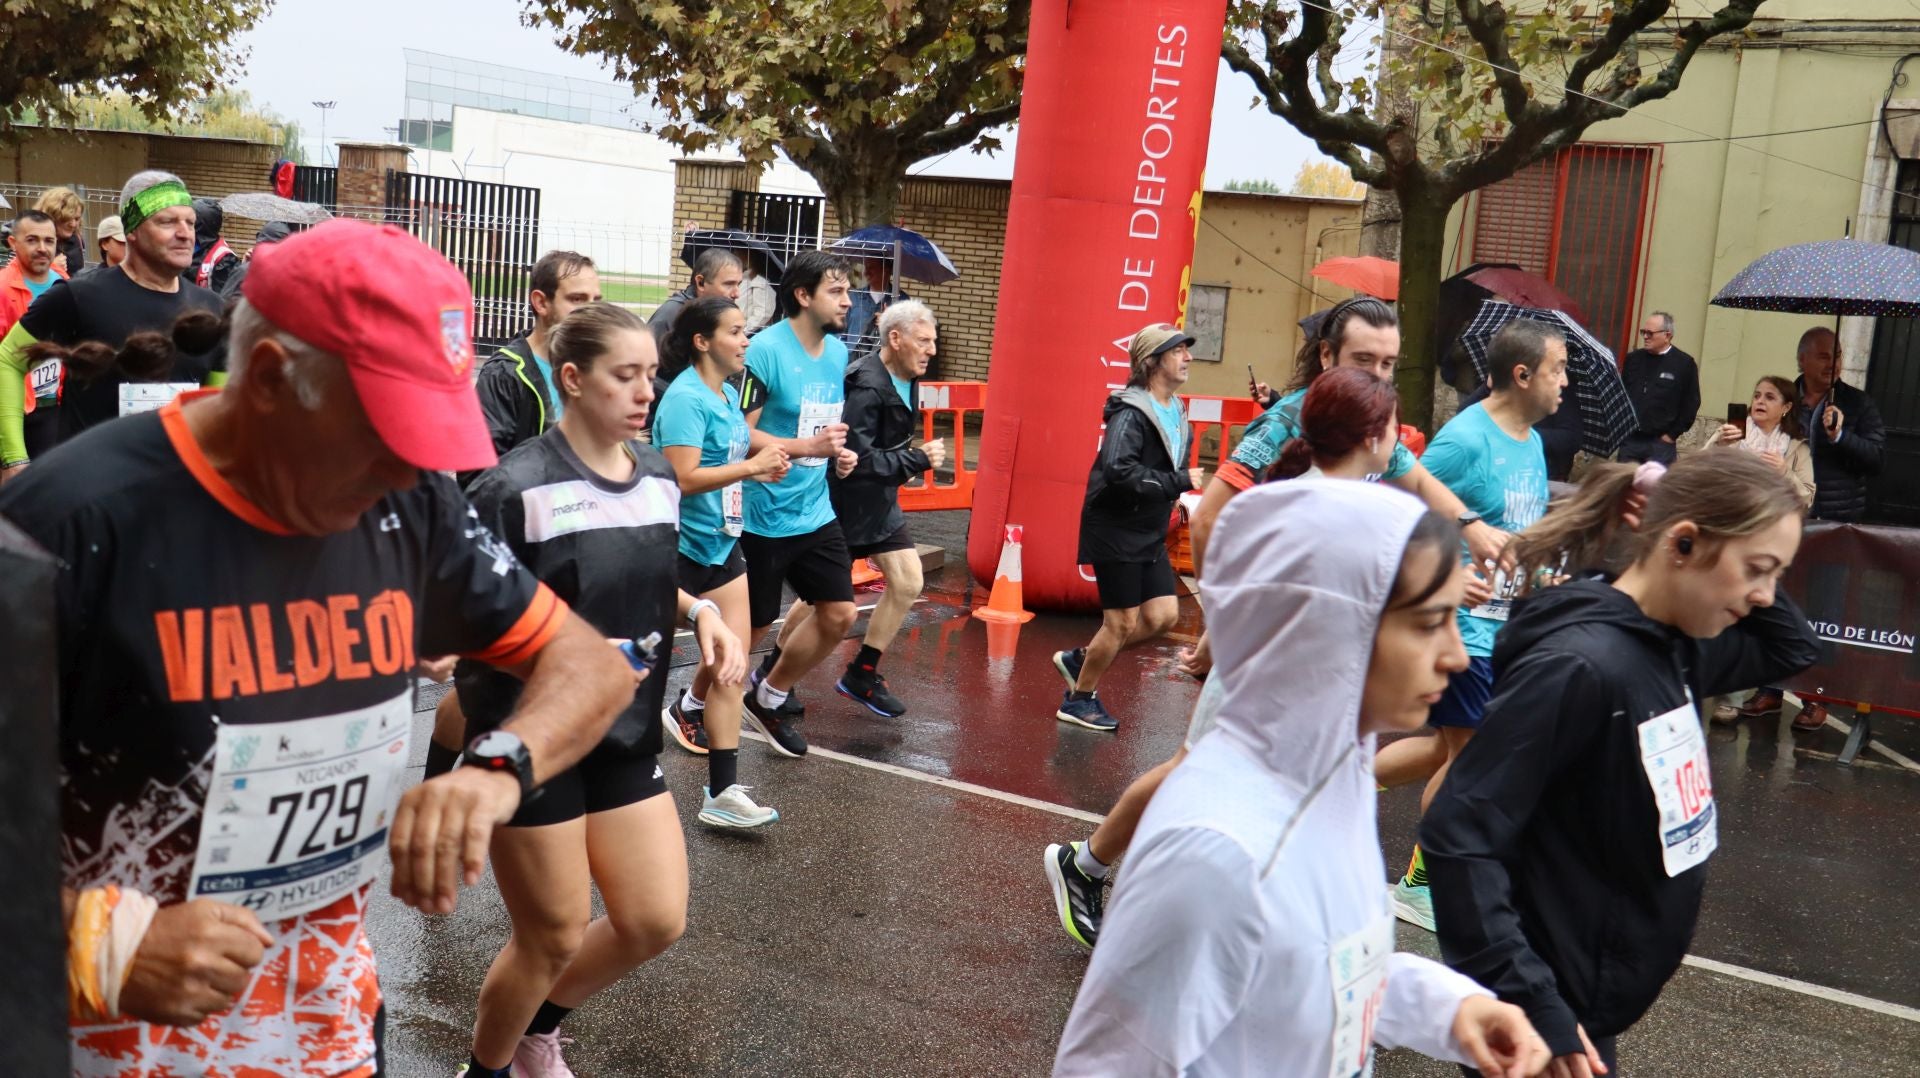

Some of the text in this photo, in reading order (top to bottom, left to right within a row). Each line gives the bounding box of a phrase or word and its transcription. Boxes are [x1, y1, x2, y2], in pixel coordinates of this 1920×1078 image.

[1117, 24, 1188, 312] DE DEPORTES
[33, 362, 58, 386] 722
[1844, 626, 1866, 640] DE
[1870, 630, 1915, 647] LEÓN
[267, 775, 369, 864] 729
